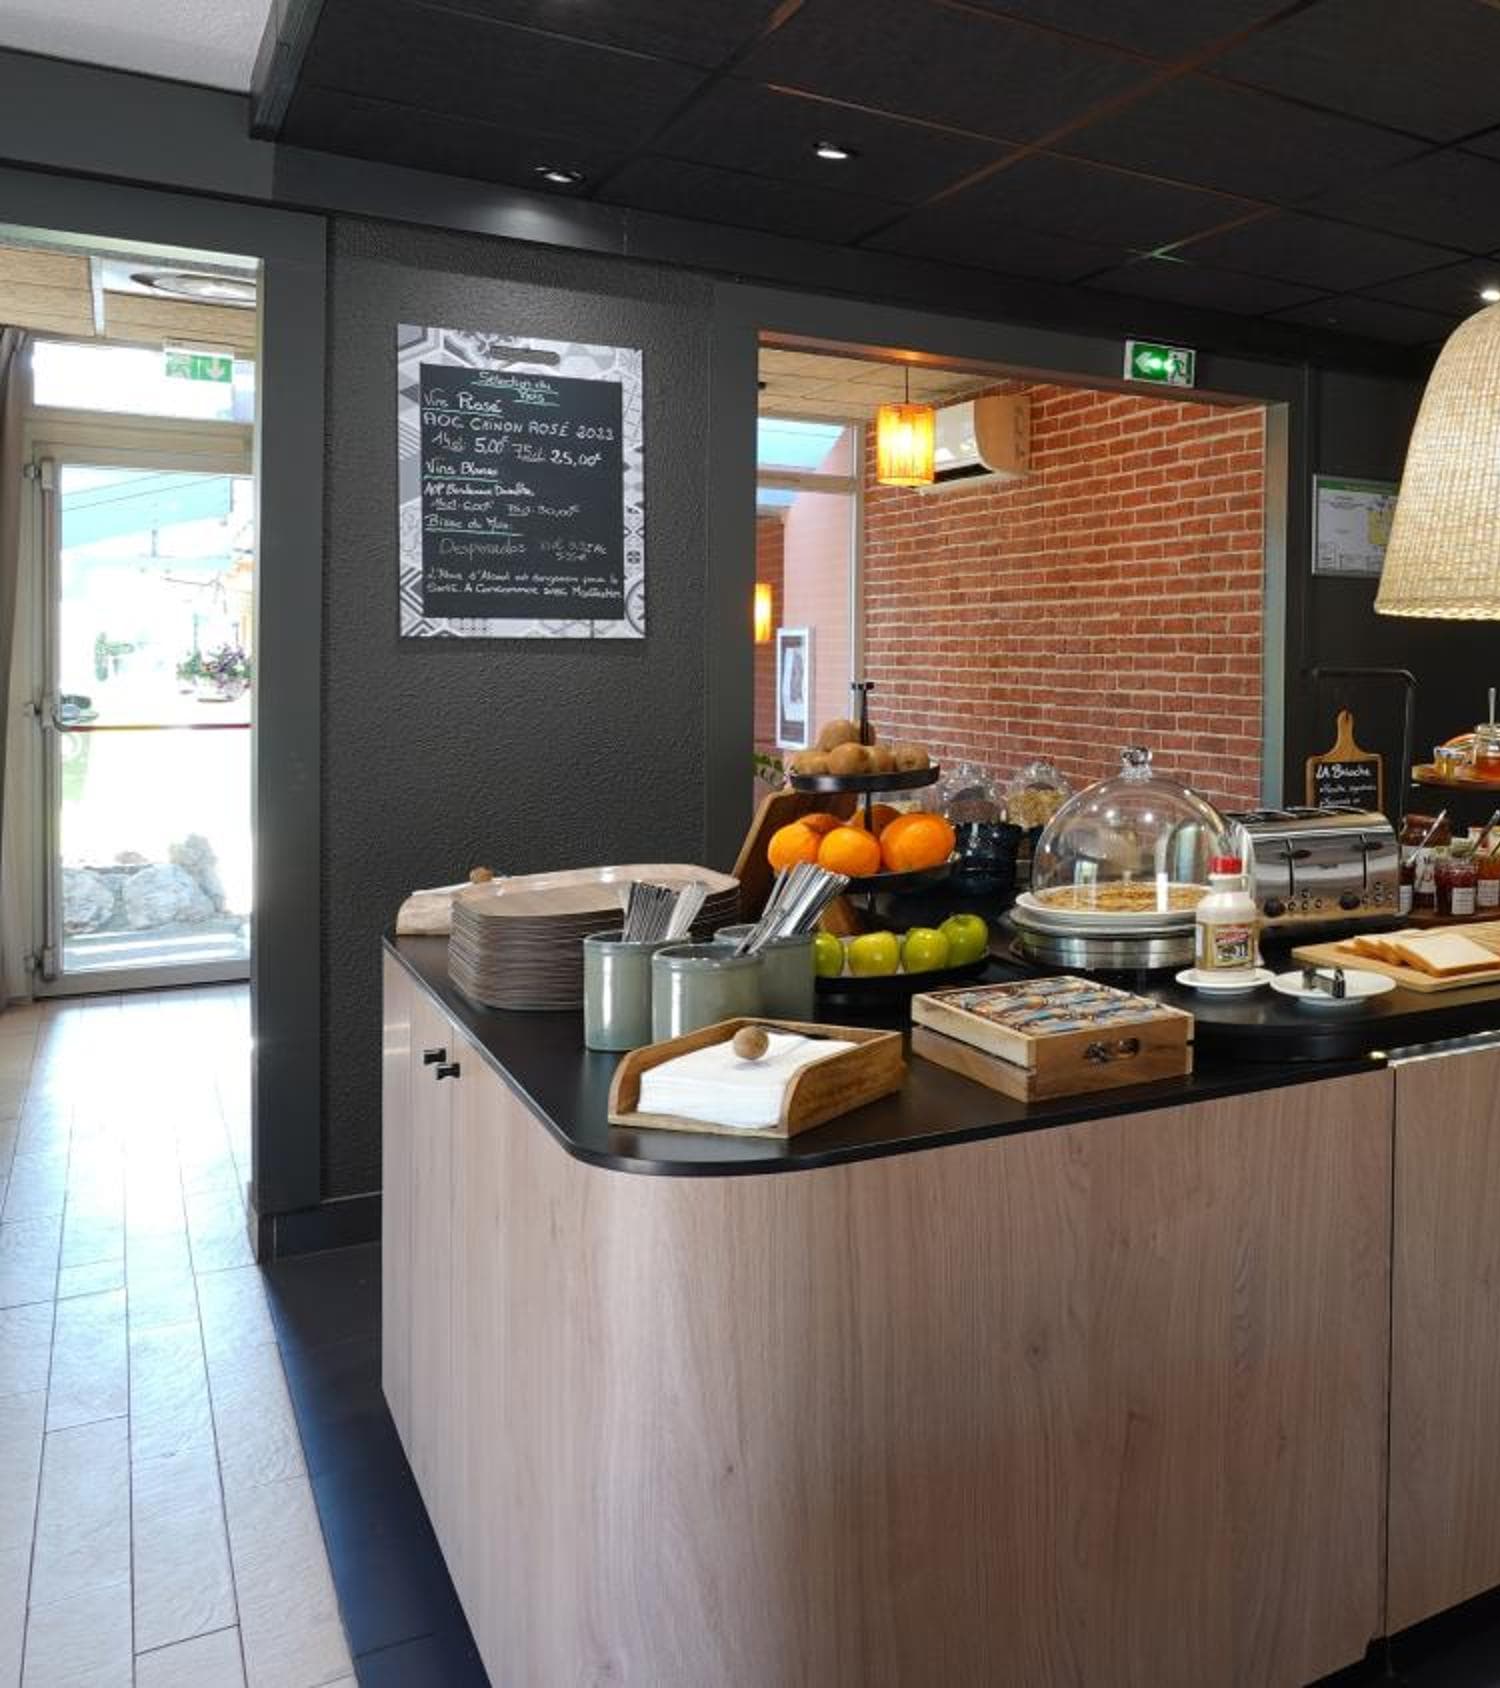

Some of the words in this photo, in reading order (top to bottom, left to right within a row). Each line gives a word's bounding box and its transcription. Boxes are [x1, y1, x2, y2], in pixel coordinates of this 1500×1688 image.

[457, 391, 502, 413] Rosé
[422, 412, 465, 430] AOC
[528, 421, 570, 437] ROSÉ
